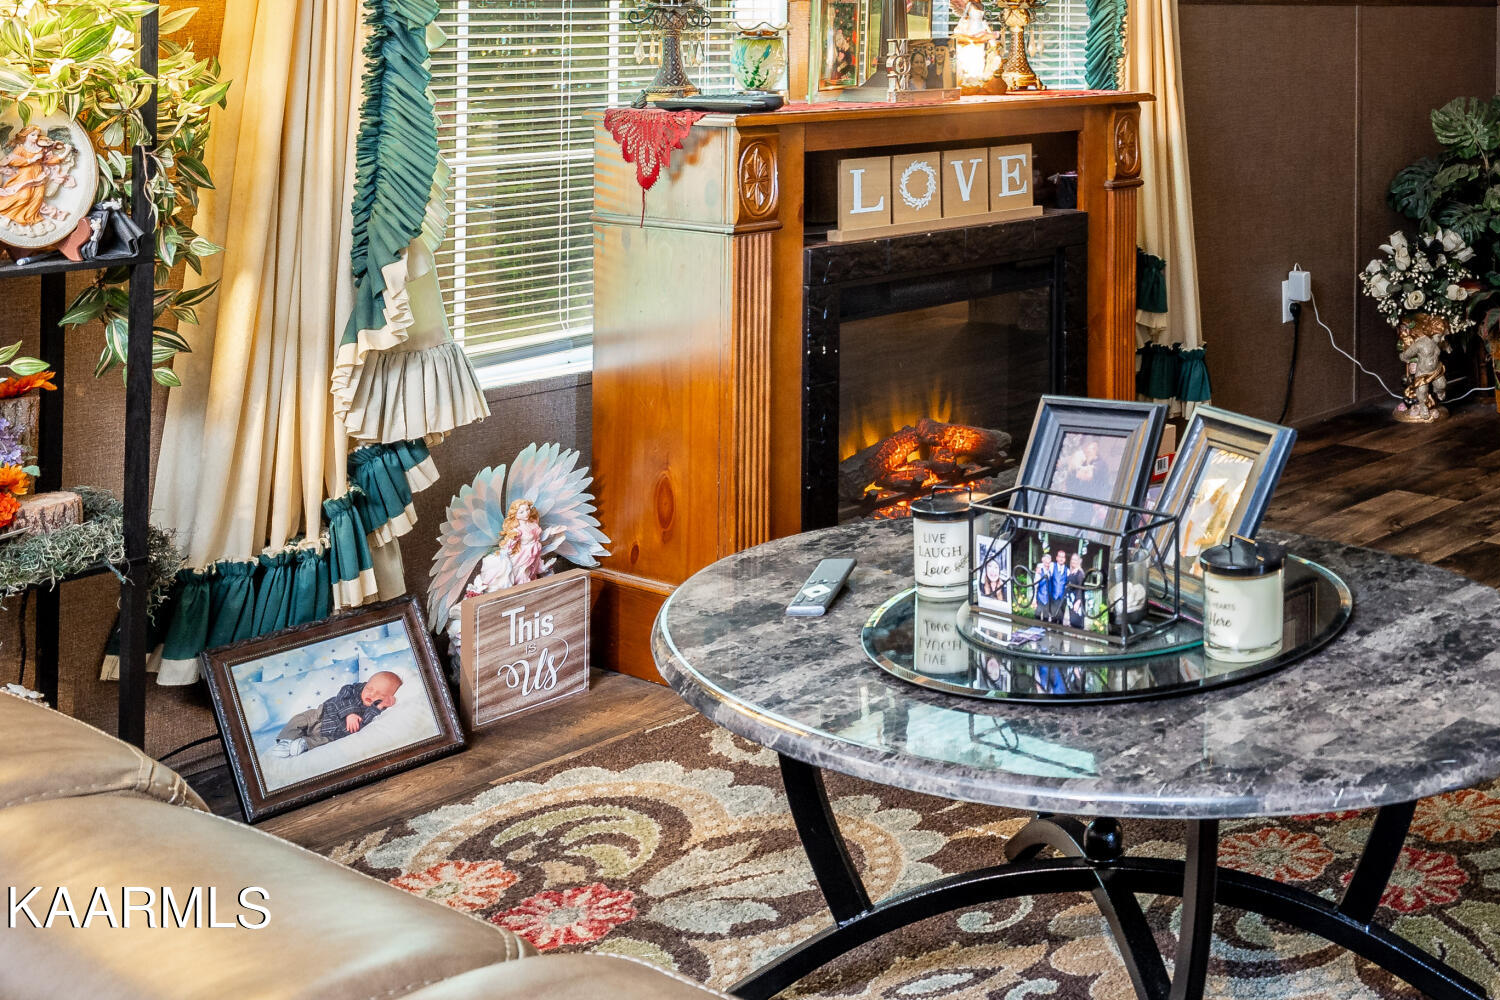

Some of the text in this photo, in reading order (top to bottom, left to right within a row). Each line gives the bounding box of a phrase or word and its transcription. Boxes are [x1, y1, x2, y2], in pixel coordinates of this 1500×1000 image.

[850, 153, 1028, 214] LOVE
[923, 532, 946, 544] LIVE
[919, 545, 962, 558] LAUGH
[923, 560, 951, 577] Love
[501, 606, 555, 647] This
